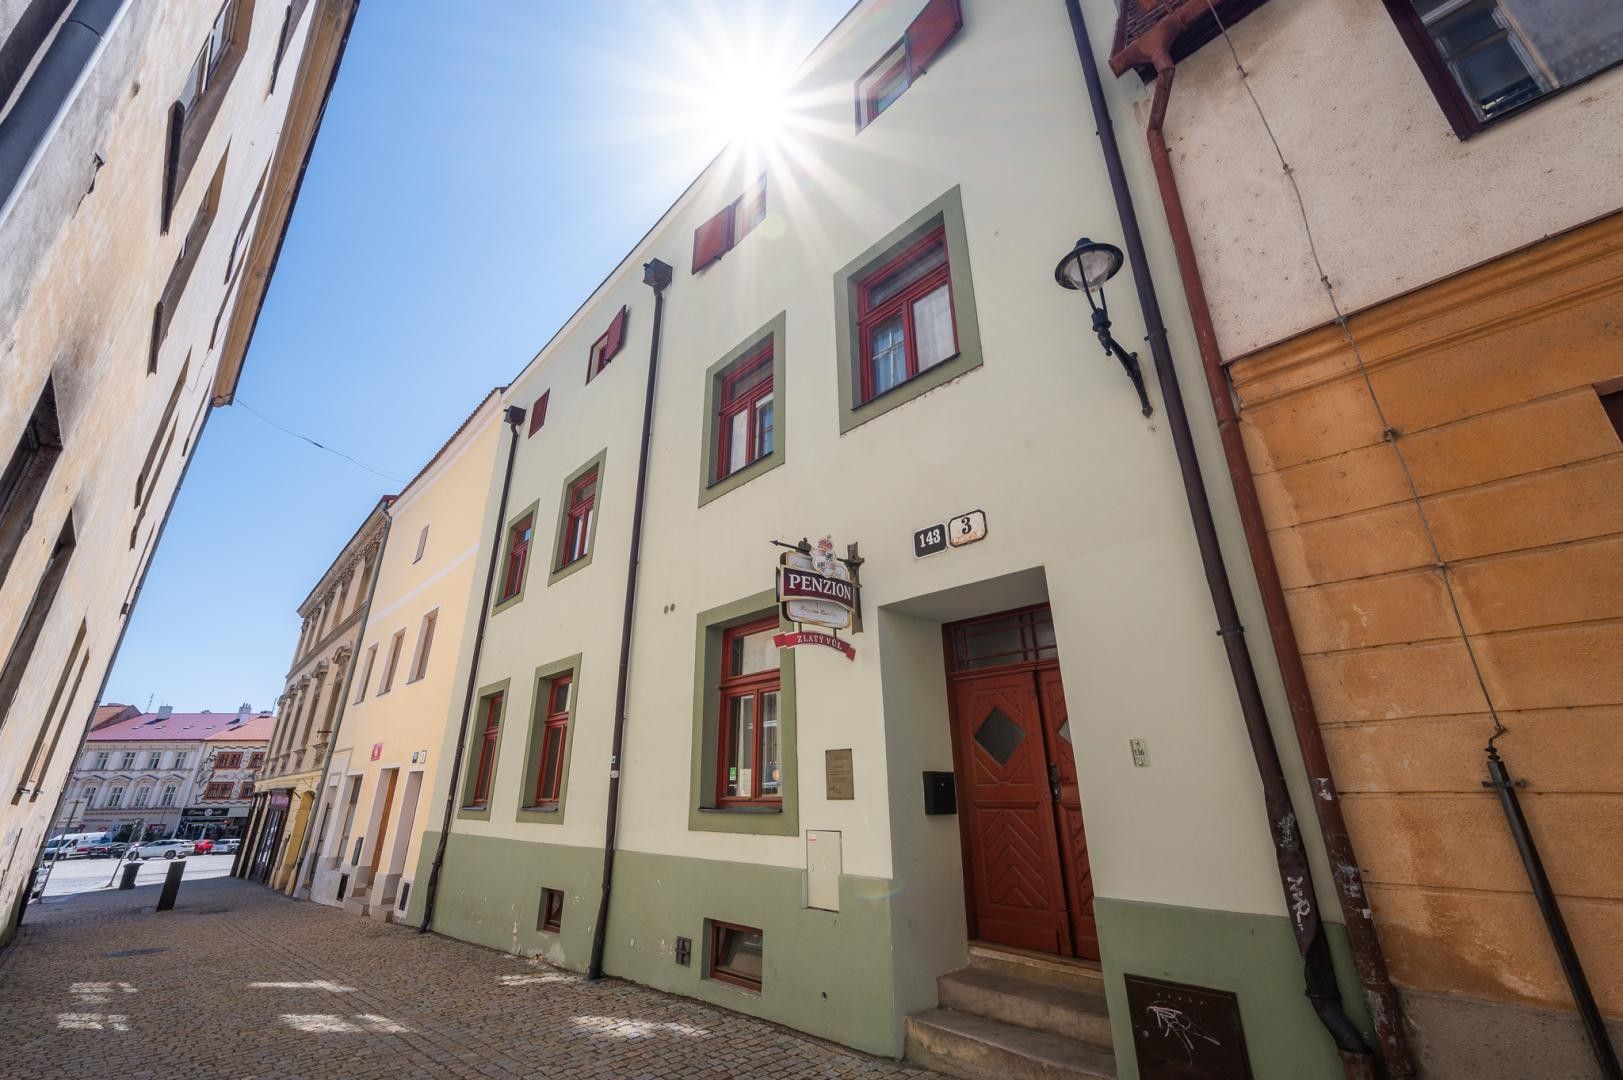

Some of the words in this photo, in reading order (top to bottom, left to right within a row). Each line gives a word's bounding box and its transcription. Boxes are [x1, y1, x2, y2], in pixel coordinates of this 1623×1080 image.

[961, 516, 972, 534] 3
[919, 528, 941, 548] 143
[788, 574, 851, 600] PENZION
